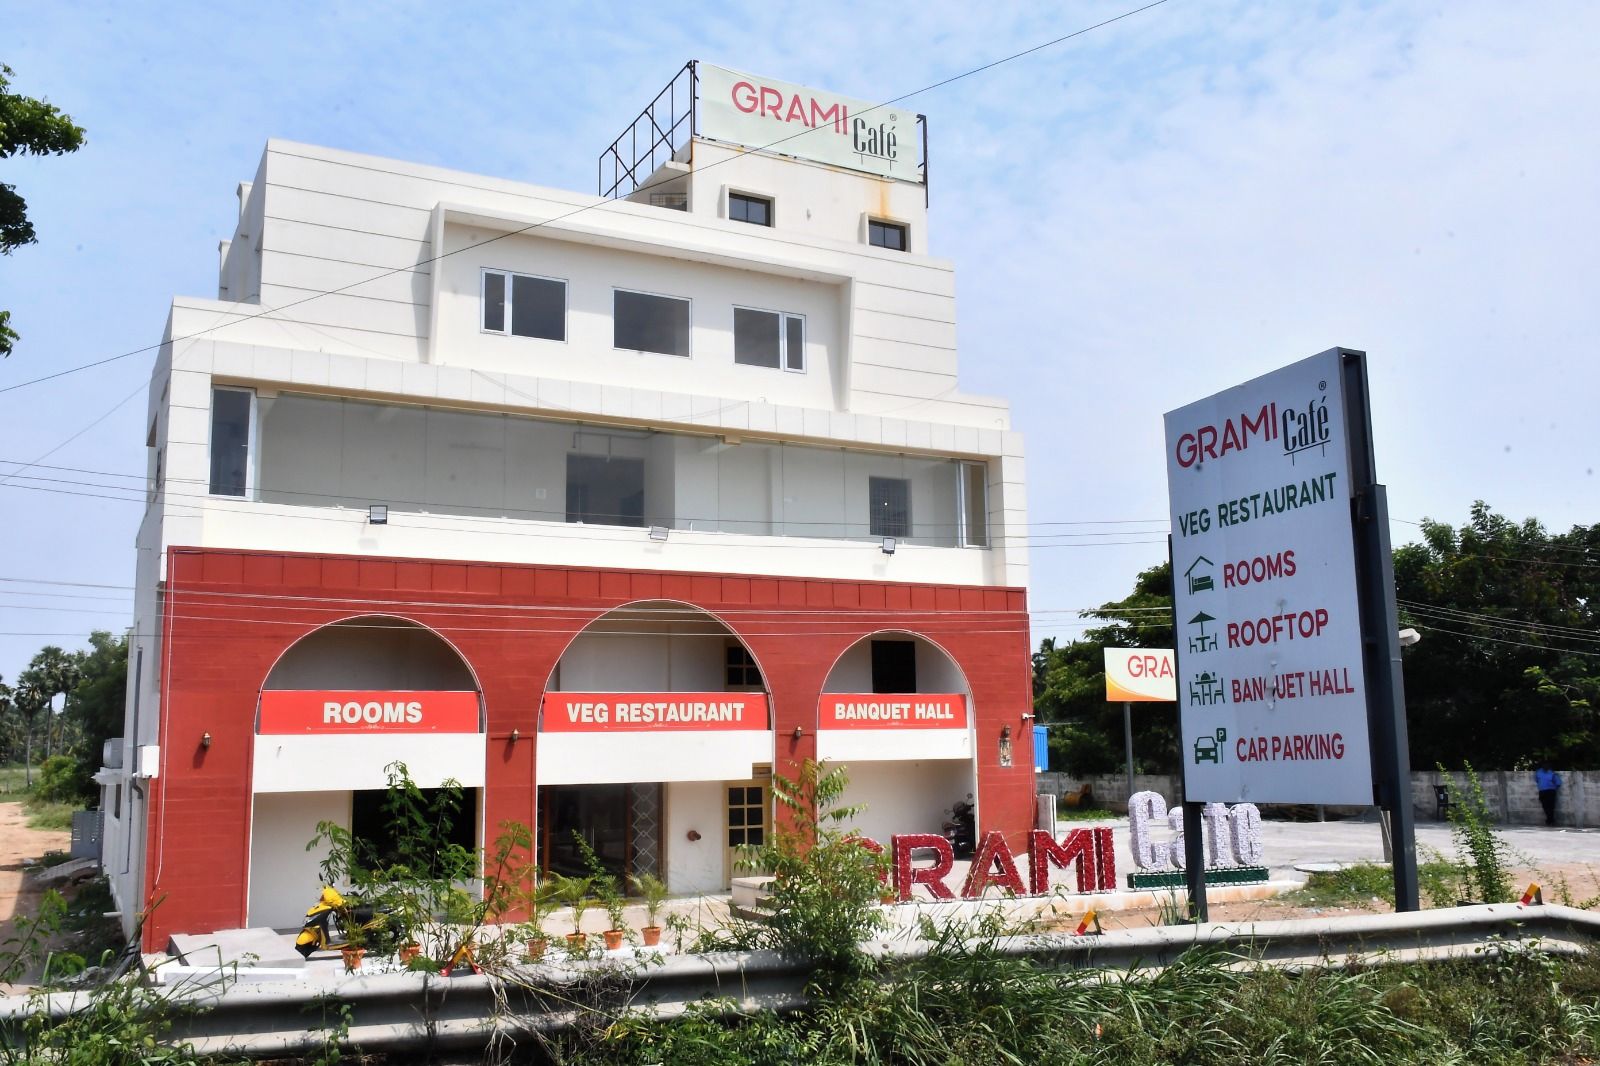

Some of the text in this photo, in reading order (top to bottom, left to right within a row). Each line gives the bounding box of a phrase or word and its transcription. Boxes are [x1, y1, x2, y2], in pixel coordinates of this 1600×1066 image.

[731, 81, 897, 159] GRAMI Café
[1176, 396, 1329, 468] GRAMI Café
[1179, 472, 1337, 537] VEG RESTAURANT
[1223, 550, 1297, 588] ROOMS
[1227, 608, 1329, 648] ROOFTOP
[1231, 667, 1355, 703] BANUET HALL
[323, 701, 423, 724] ROOMS
[566, 702, 745, 724] VEG RESTAURANT
[834, 702, 954, 721] BANQUET HALL
[1236, 733, 1345, 762] CAR PARKING
